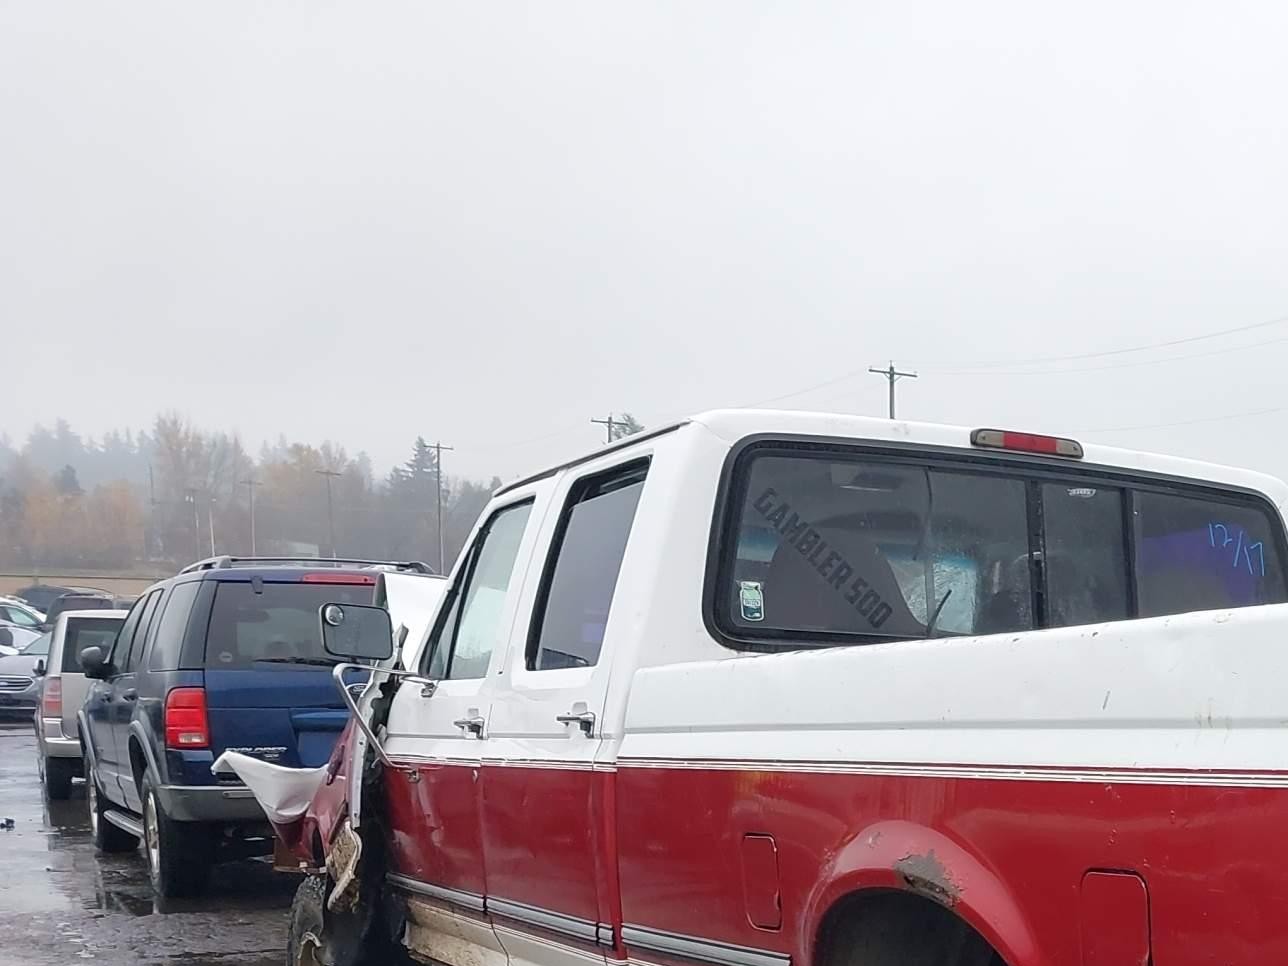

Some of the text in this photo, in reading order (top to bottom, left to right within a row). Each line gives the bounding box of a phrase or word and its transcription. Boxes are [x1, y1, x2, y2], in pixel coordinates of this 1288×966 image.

[752, 487, 894, 630] GAMBLER 500
[1208, 522, 1265, 577] 12/17
